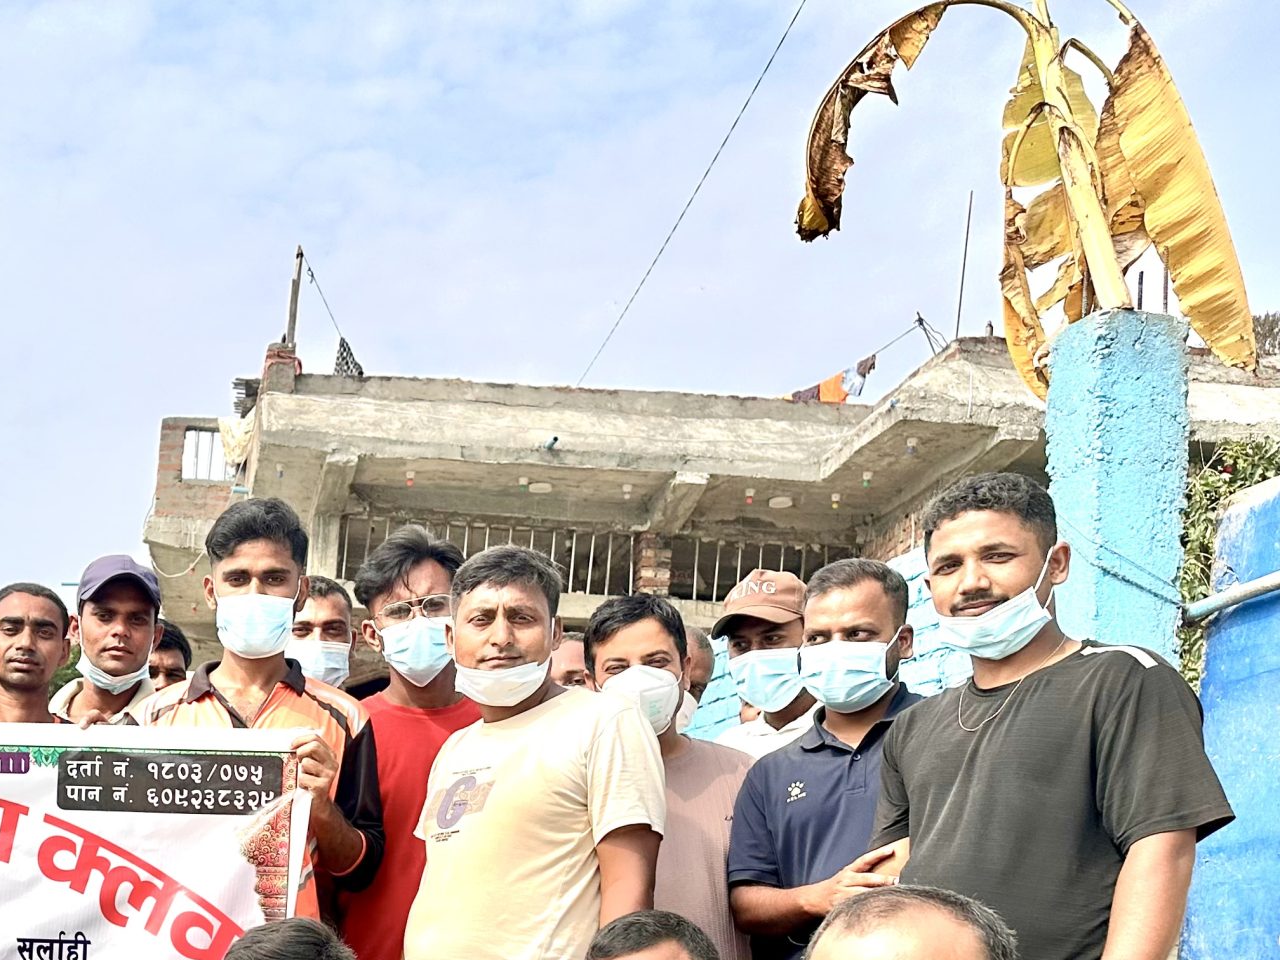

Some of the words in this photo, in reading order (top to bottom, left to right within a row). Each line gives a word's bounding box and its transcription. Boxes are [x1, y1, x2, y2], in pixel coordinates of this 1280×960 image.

[66, 756, 103, 779] दर्ता
[147, 762, 264, 785] १८०३/०७५
[65, 785, 103, 803] पान
